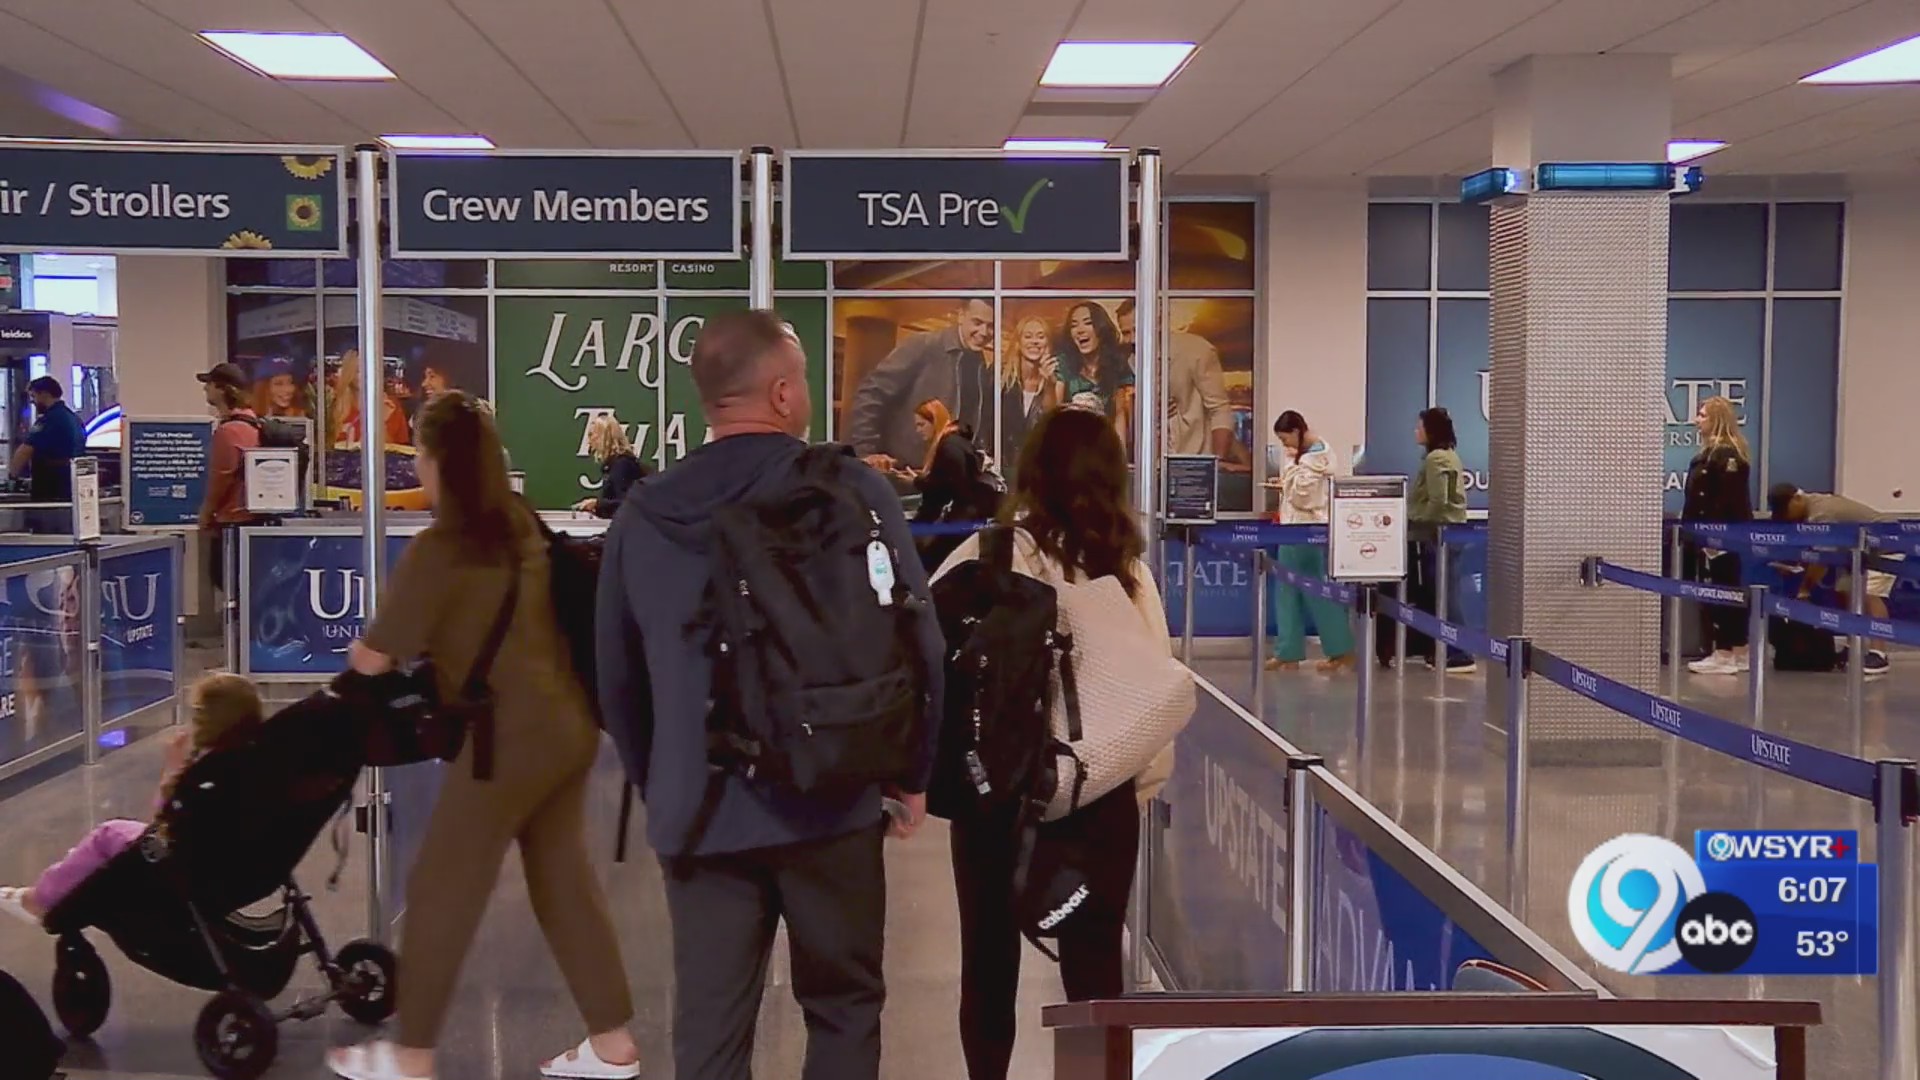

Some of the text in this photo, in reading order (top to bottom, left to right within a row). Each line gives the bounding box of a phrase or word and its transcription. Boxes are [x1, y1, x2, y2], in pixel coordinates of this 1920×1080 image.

[69, 183, 231, 218] Strollers
[422, 188, 709, 223] Crew Members
[859, 192, 928, 226] TSA
[609, 263, 715, 273] RESORT CASINO
[1, 330, 33, 338] leidos
[1749, 532, 1787, 543] UPSTATE
[1168, 561, 1248, 586] TATE
[127, 624, 154, 644] UPSTATE
[1571, 667, 1598, 693] UPSTATE
[1651, 700, 1681, 729] UPSTATE
[1751, 733, 1792, 765] UPSTATE
[1204, 755, 1288, 934] UPSTATE
